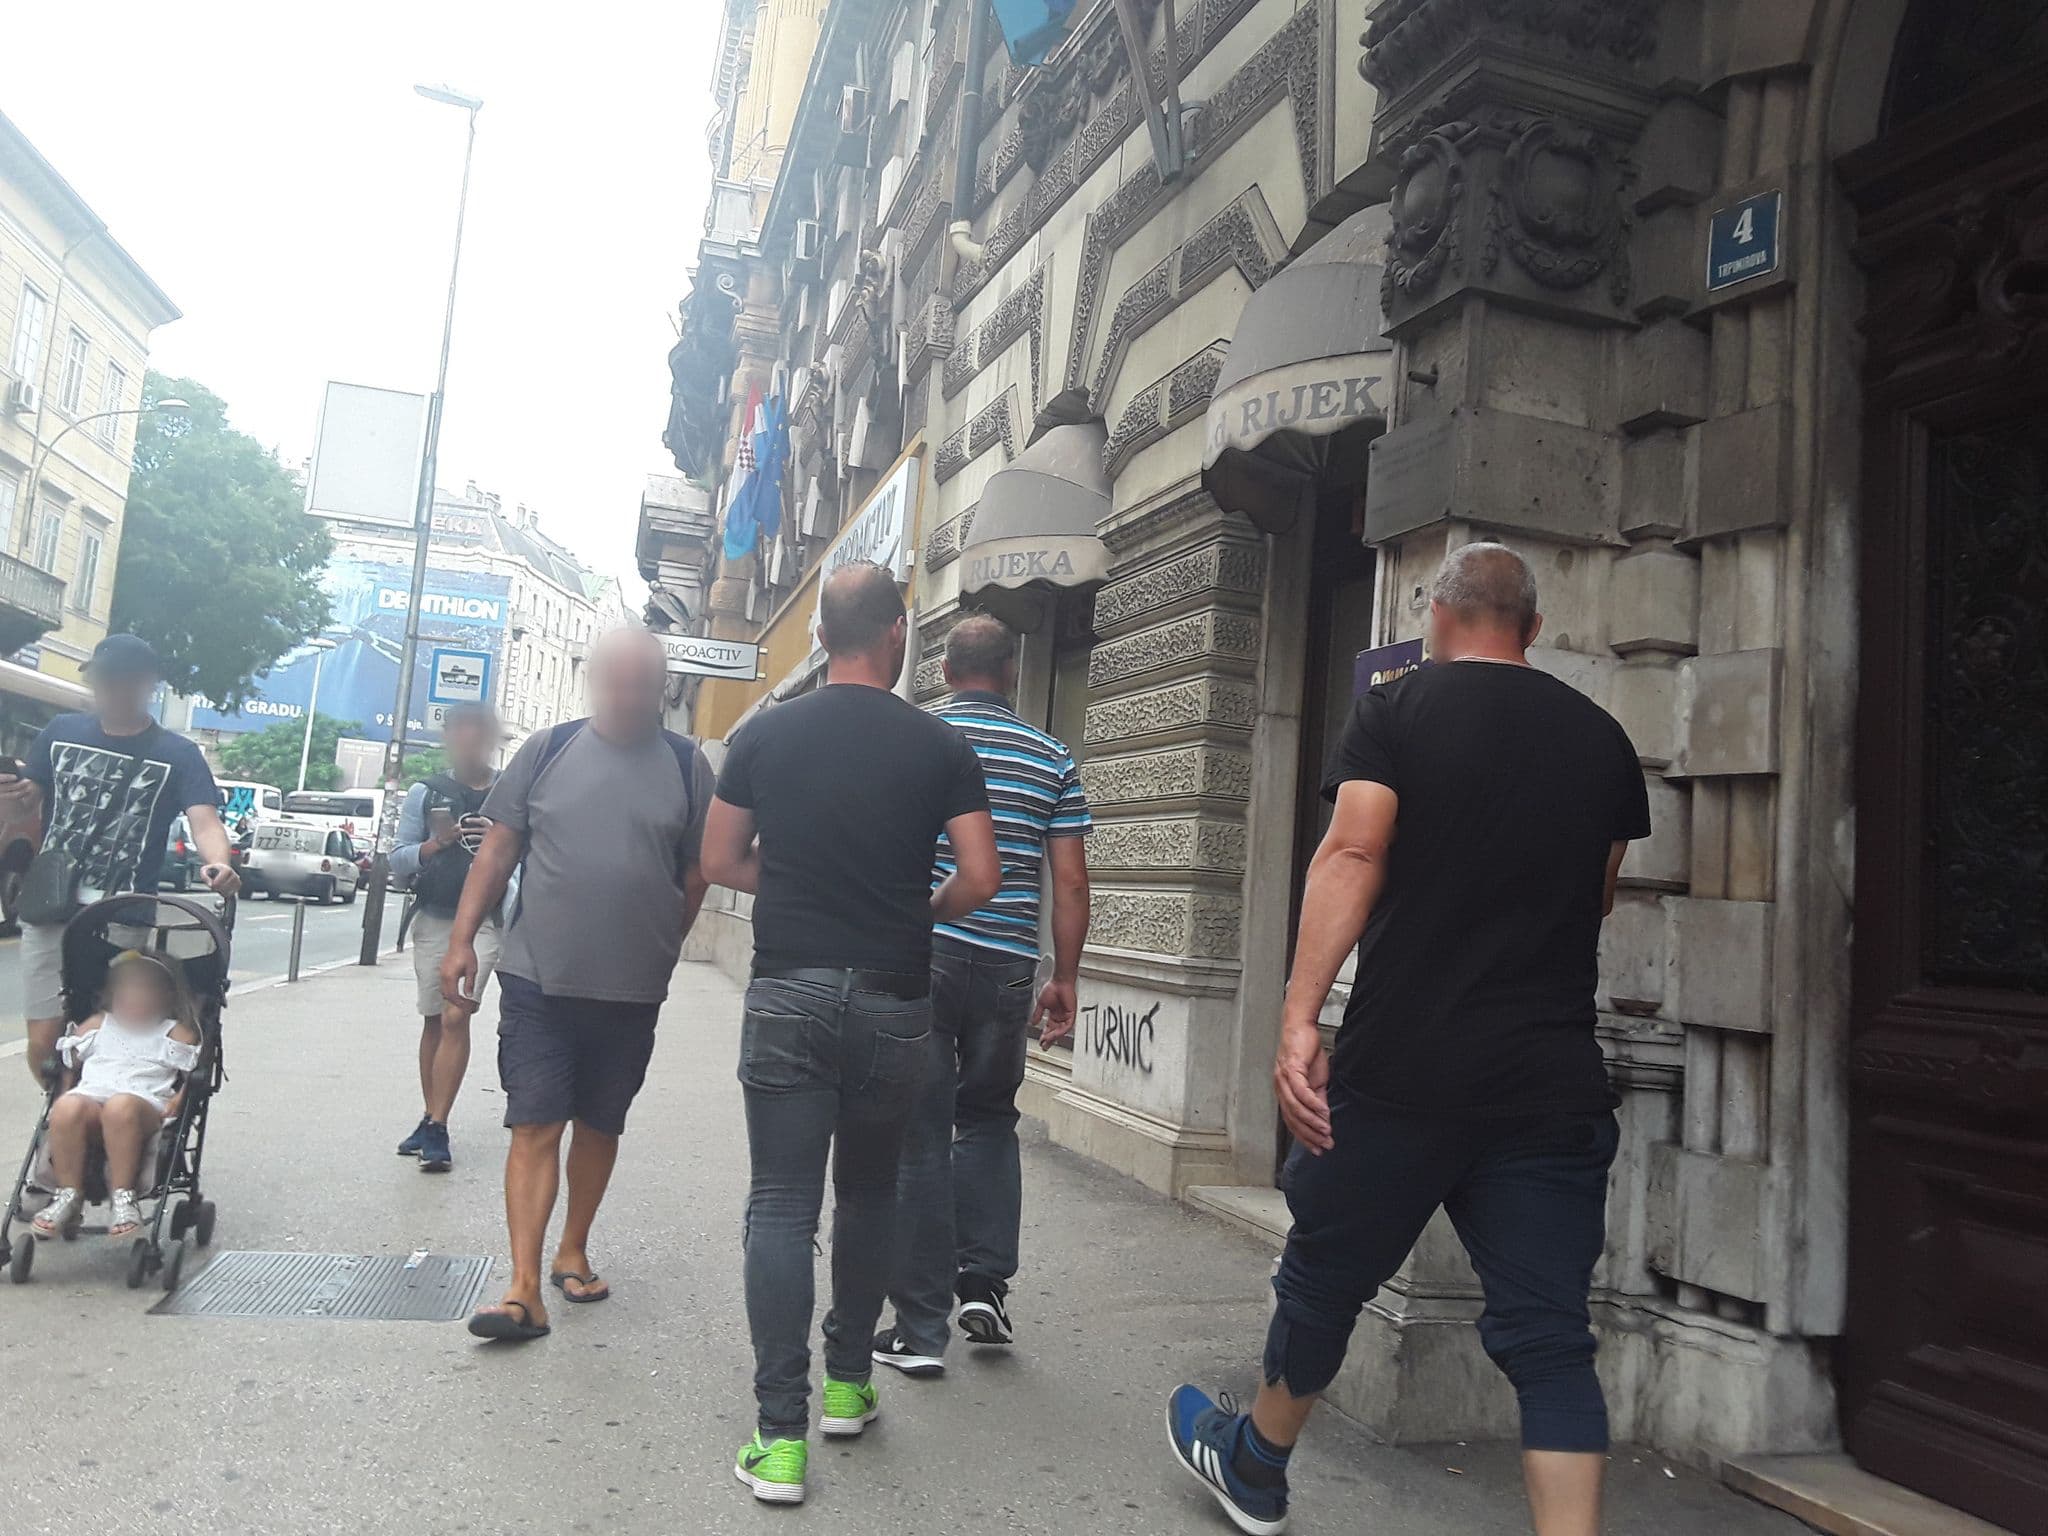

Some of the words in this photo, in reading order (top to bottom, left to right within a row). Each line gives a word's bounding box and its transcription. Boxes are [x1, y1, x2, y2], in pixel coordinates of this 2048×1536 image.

[1732, 207, 1754, 245] 4
[1239, 376, 1388, 438] RIJEK
[970, 550, 1075, 582] RIJEKA
[378, 588, 500, 621] DEATHLON
[664, 642, 742, 661] RGOACTIV
[245, 700, 304, 719] GRADU.
[1080, 1001, 1160, 1074] TURNIĆ
